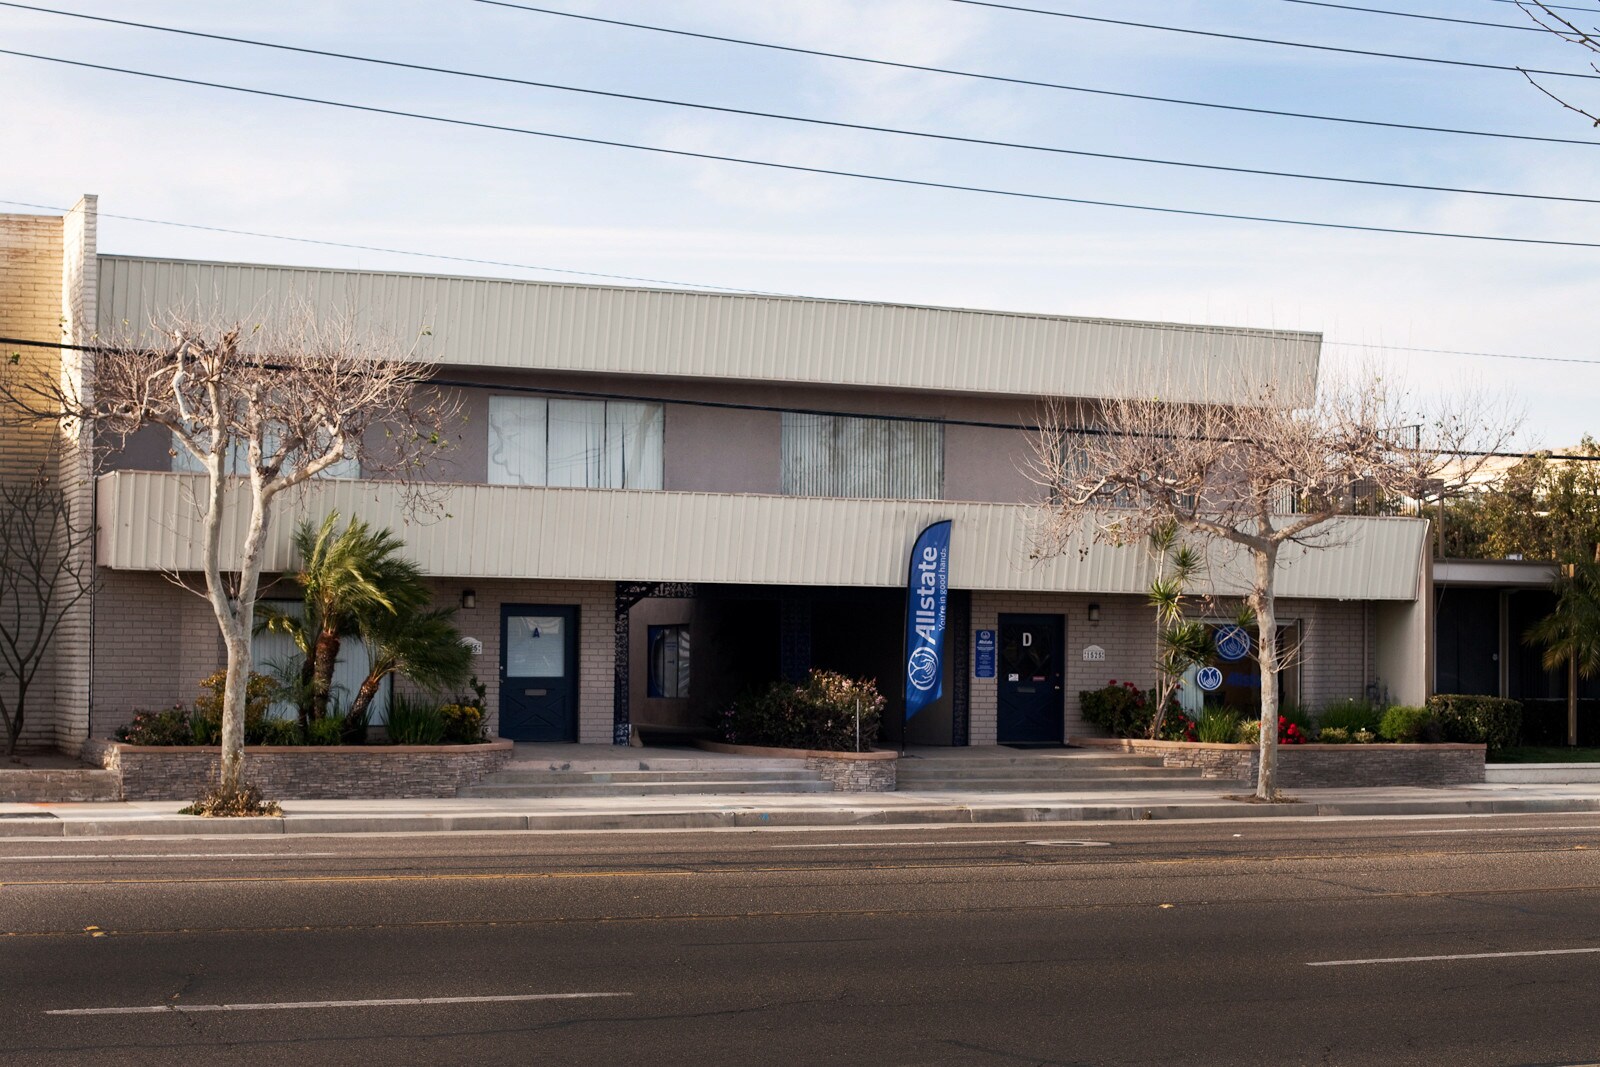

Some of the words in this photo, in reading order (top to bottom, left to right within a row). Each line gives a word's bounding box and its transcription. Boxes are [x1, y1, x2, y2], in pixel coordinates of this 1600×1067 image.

[938, 546, 947, 573] hands.
[938, 574, 948, 595] good
[915, 546, 938, 645] Allstate
[938, 596, 947, 604] in
[938, 605, 947, 632] You're
[532, 627, 540, 638] A
[1022, 632, 1032, 647] D
